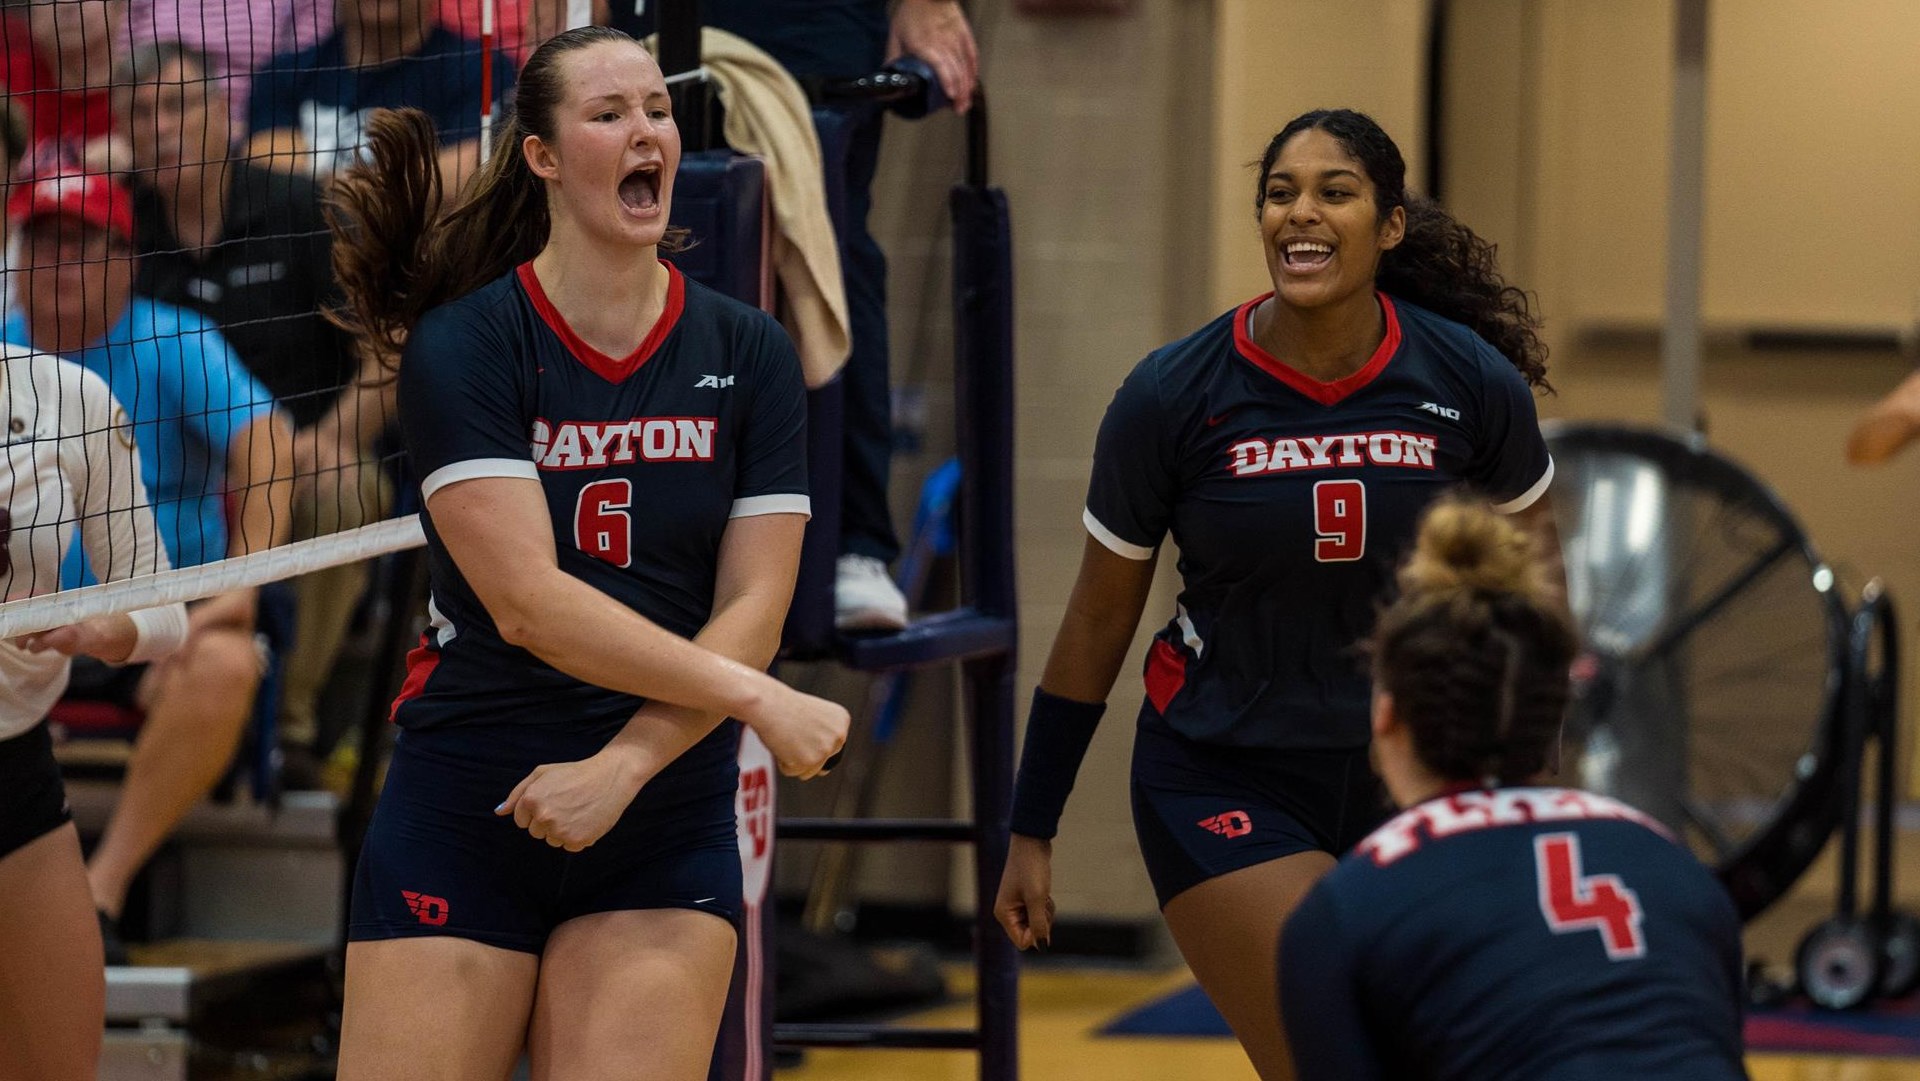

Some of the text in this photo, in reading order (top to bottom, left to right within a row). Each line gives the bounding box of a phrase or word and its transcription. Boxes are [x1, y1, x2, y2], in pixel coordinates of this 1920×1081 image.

[529, 416, 719, 471] DAYTON
[1226, 430, 1438, 477] DAYTON
[574, 478, 632, 568] 6
[1313, 479, 1367, 563] 9
[1534, 832, 1646, 961] 4
